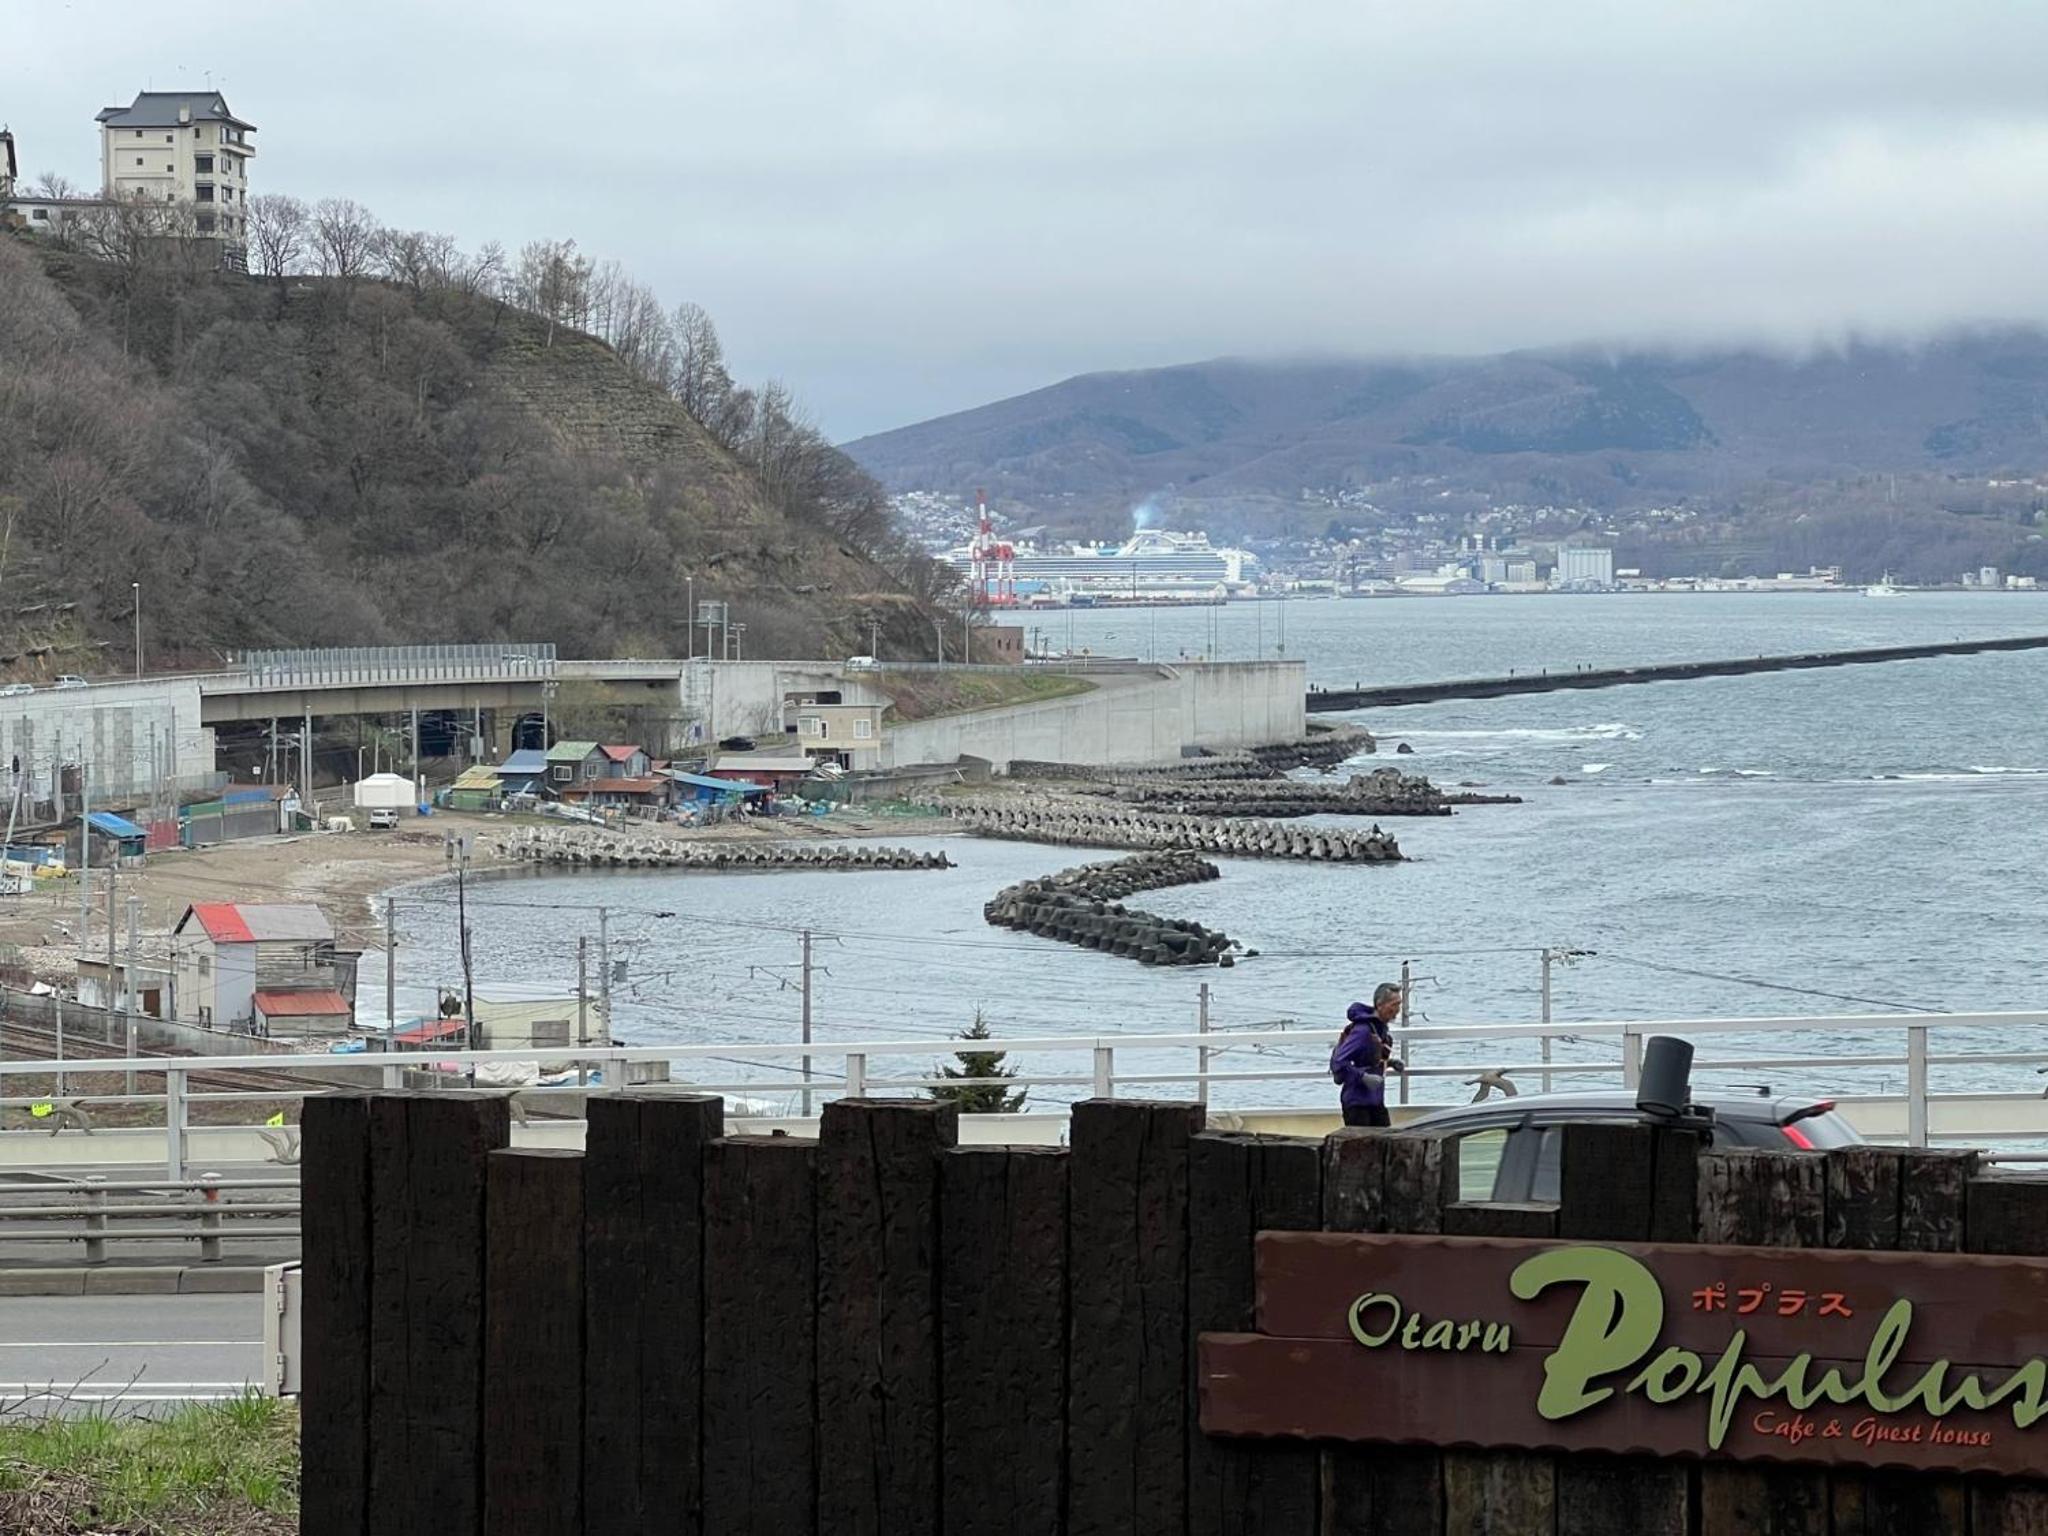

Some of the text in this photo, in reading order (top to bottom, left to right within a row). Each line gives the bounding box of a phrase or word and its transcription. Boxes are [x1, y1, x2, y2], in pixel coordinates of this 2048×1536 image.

[1692, 1281, 1853, 1318] ポプラス
[1349, 1245, 2048, 1450] Otaru Populus
[1753, 1411, 1993, 1446] Cafe & Guest house
